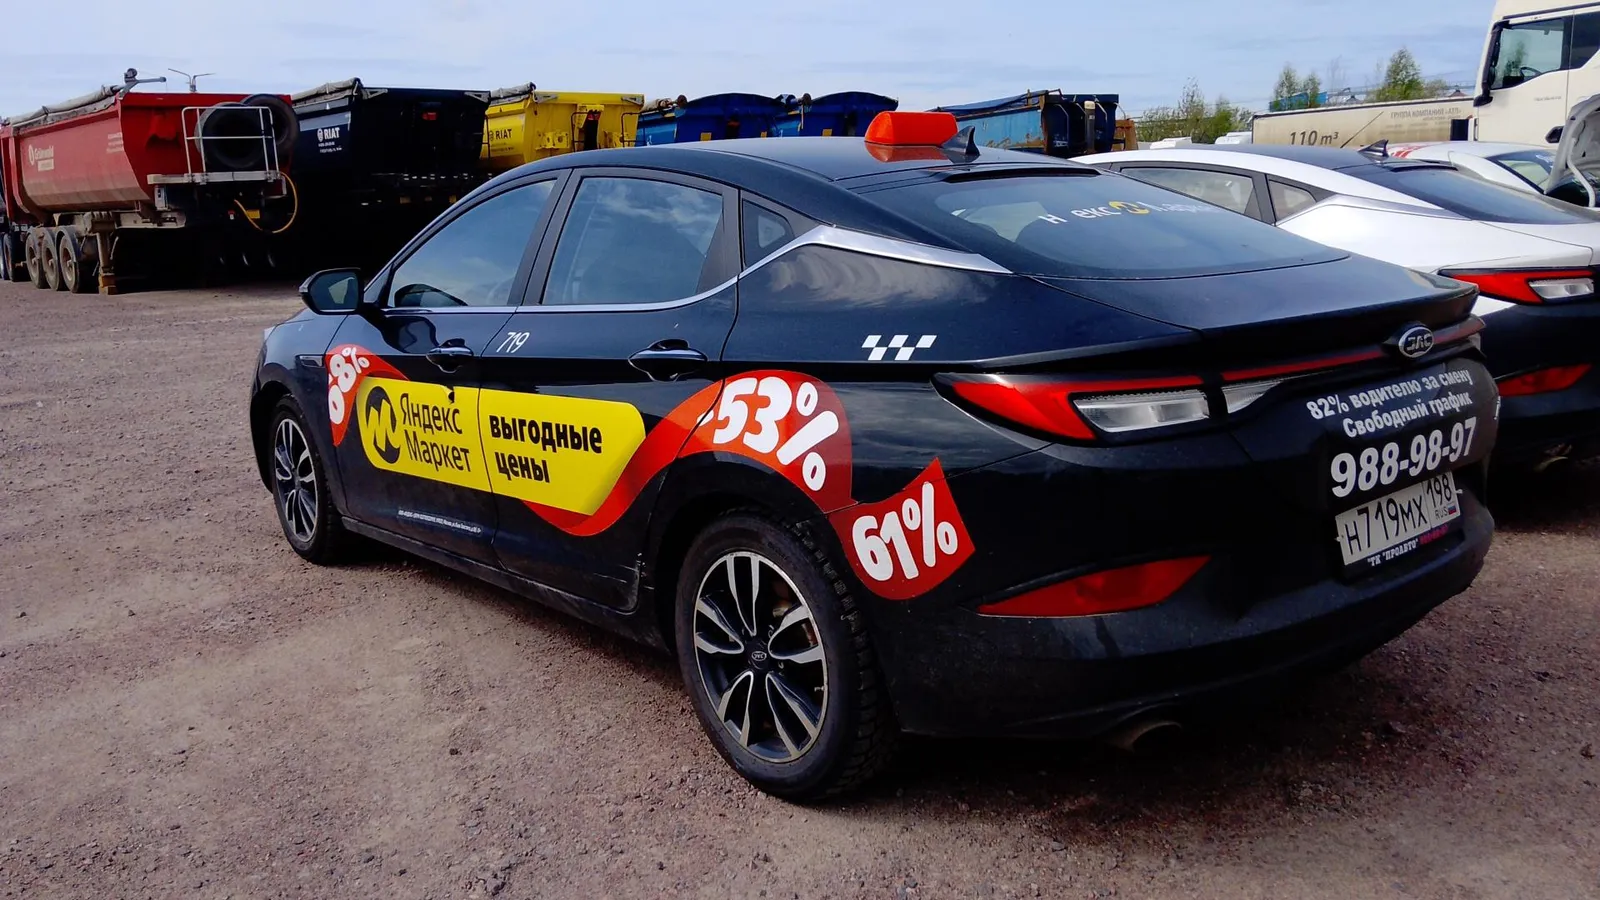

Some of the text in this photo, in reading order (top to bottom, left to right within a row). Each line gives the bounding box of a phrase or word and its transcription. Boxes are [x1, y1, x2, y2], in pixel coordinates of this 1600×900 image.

[324, 127, 340, 140] RIAT
[495, 129, 512, 140] RIAT
[1290, 130, 1318, 146] 110
[496, 331, 530, 354] 719
[1406, 333, 1432, 351] JAC
[1306, 369, 1474, 421] 82% водителю за смену
[400, 393, 463, 435] Яндекс
[1342, 398, 1430, 438] Свободный
[1429, 391, 1473, 417] график
[404, 429, 471, 472] Маркет
[488, 415, 602, 454] выгодные
[494, 451, 551, 484] цены
[1330, 416, 1477, 498] 988-98-97
[1426, 474, 1452, 508] 198
[1434, 506, 1448, 520] RUS
